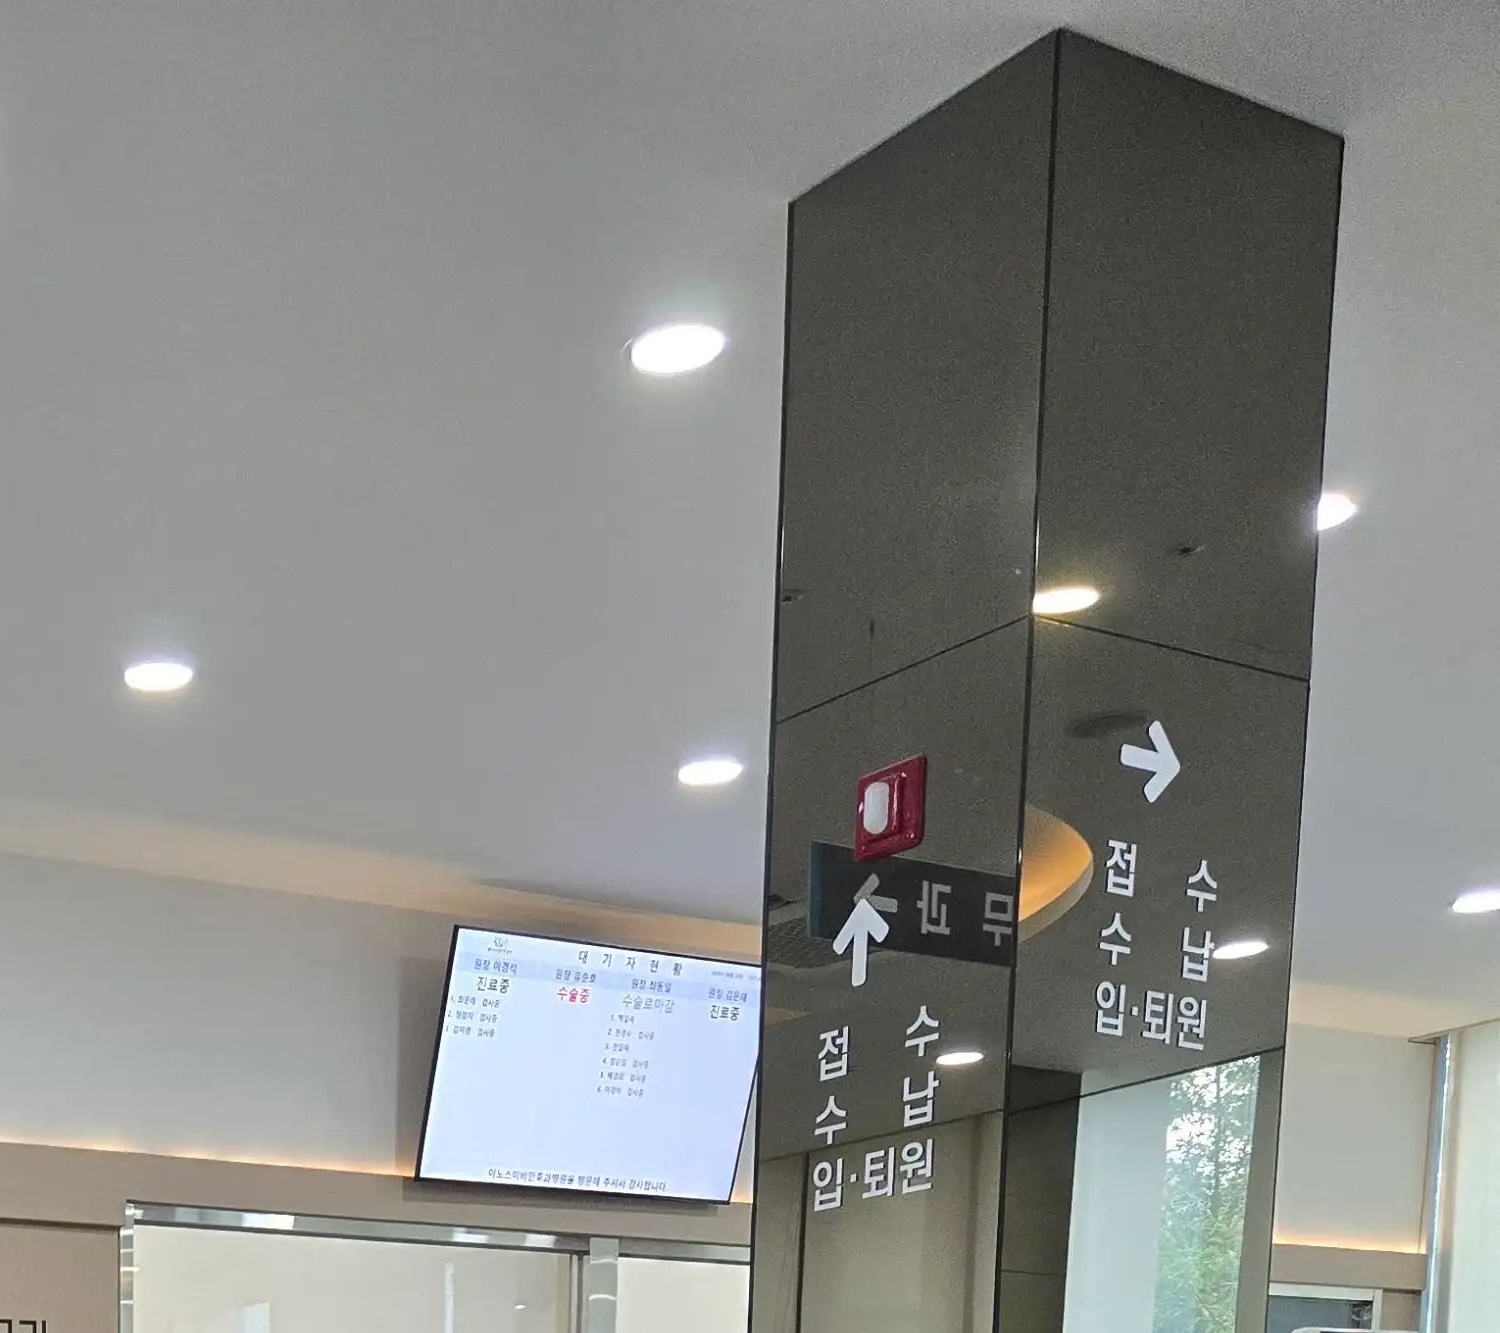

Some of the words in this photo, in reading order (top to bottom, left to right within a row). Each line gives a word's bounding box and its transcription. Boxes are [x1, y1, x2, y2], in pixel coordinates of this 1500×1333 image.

[477, 976, 510, 994] 진료중
[558, 986, 589, 1003] 수술중
[710, 1005, 739, 1021] 진료중
